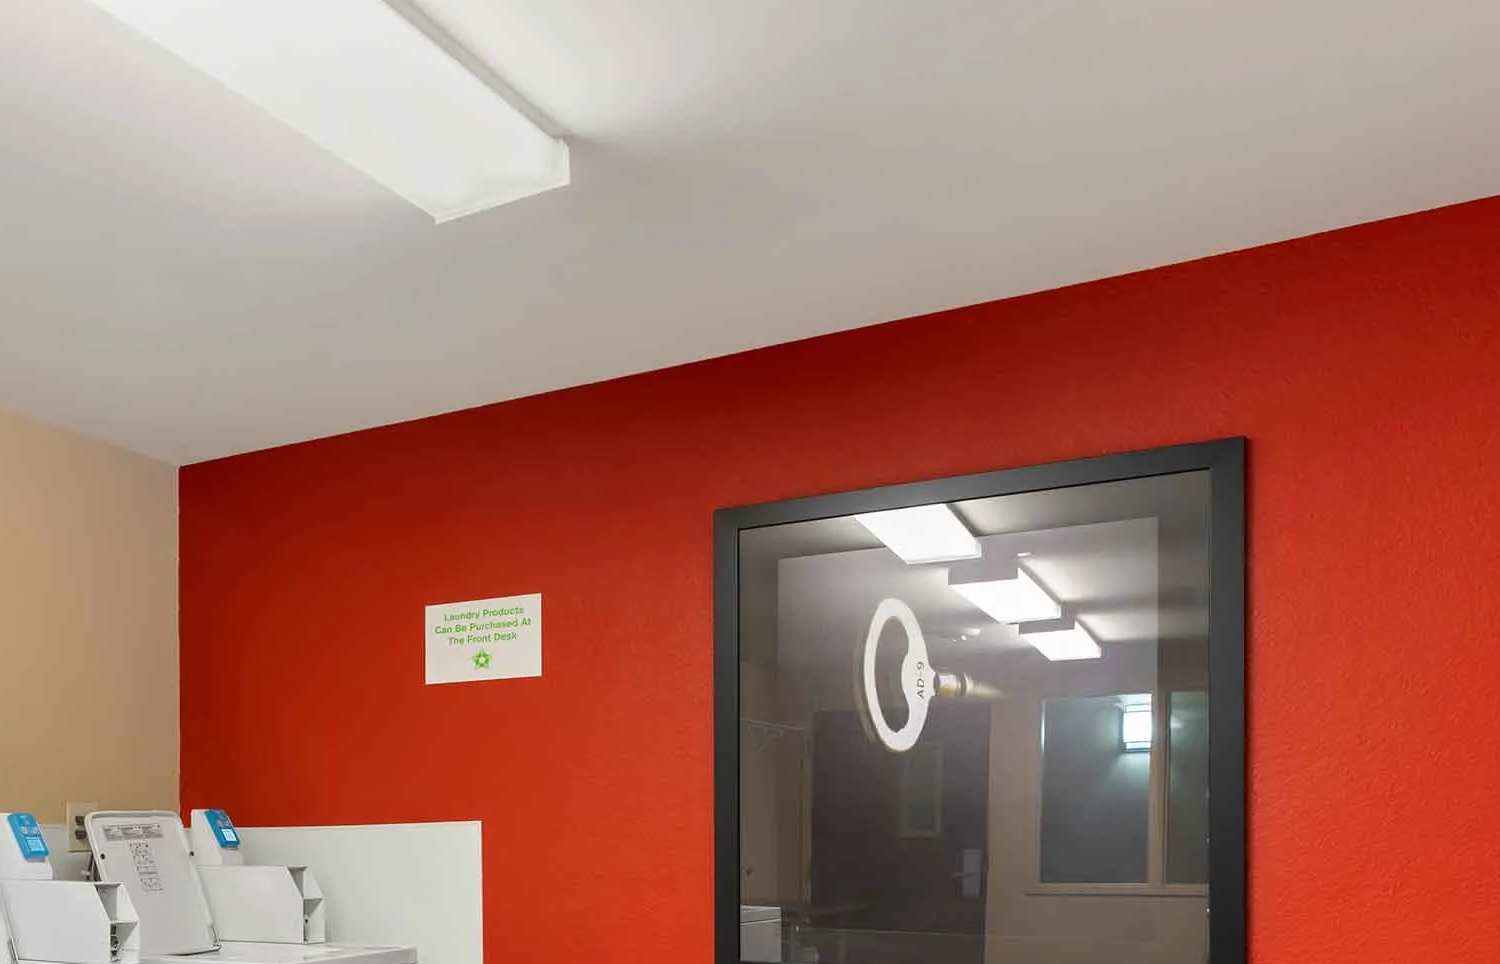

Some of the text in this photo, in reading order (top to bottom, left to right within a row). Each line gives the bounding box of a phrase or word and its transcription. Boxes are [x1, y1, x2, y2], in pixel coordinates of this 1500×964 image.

[444, 607, 524, 622] Laundry Products
[435, 618, 532, 634] Can Be Purchased At
[449, 631, 517, 646] The Front Desk
